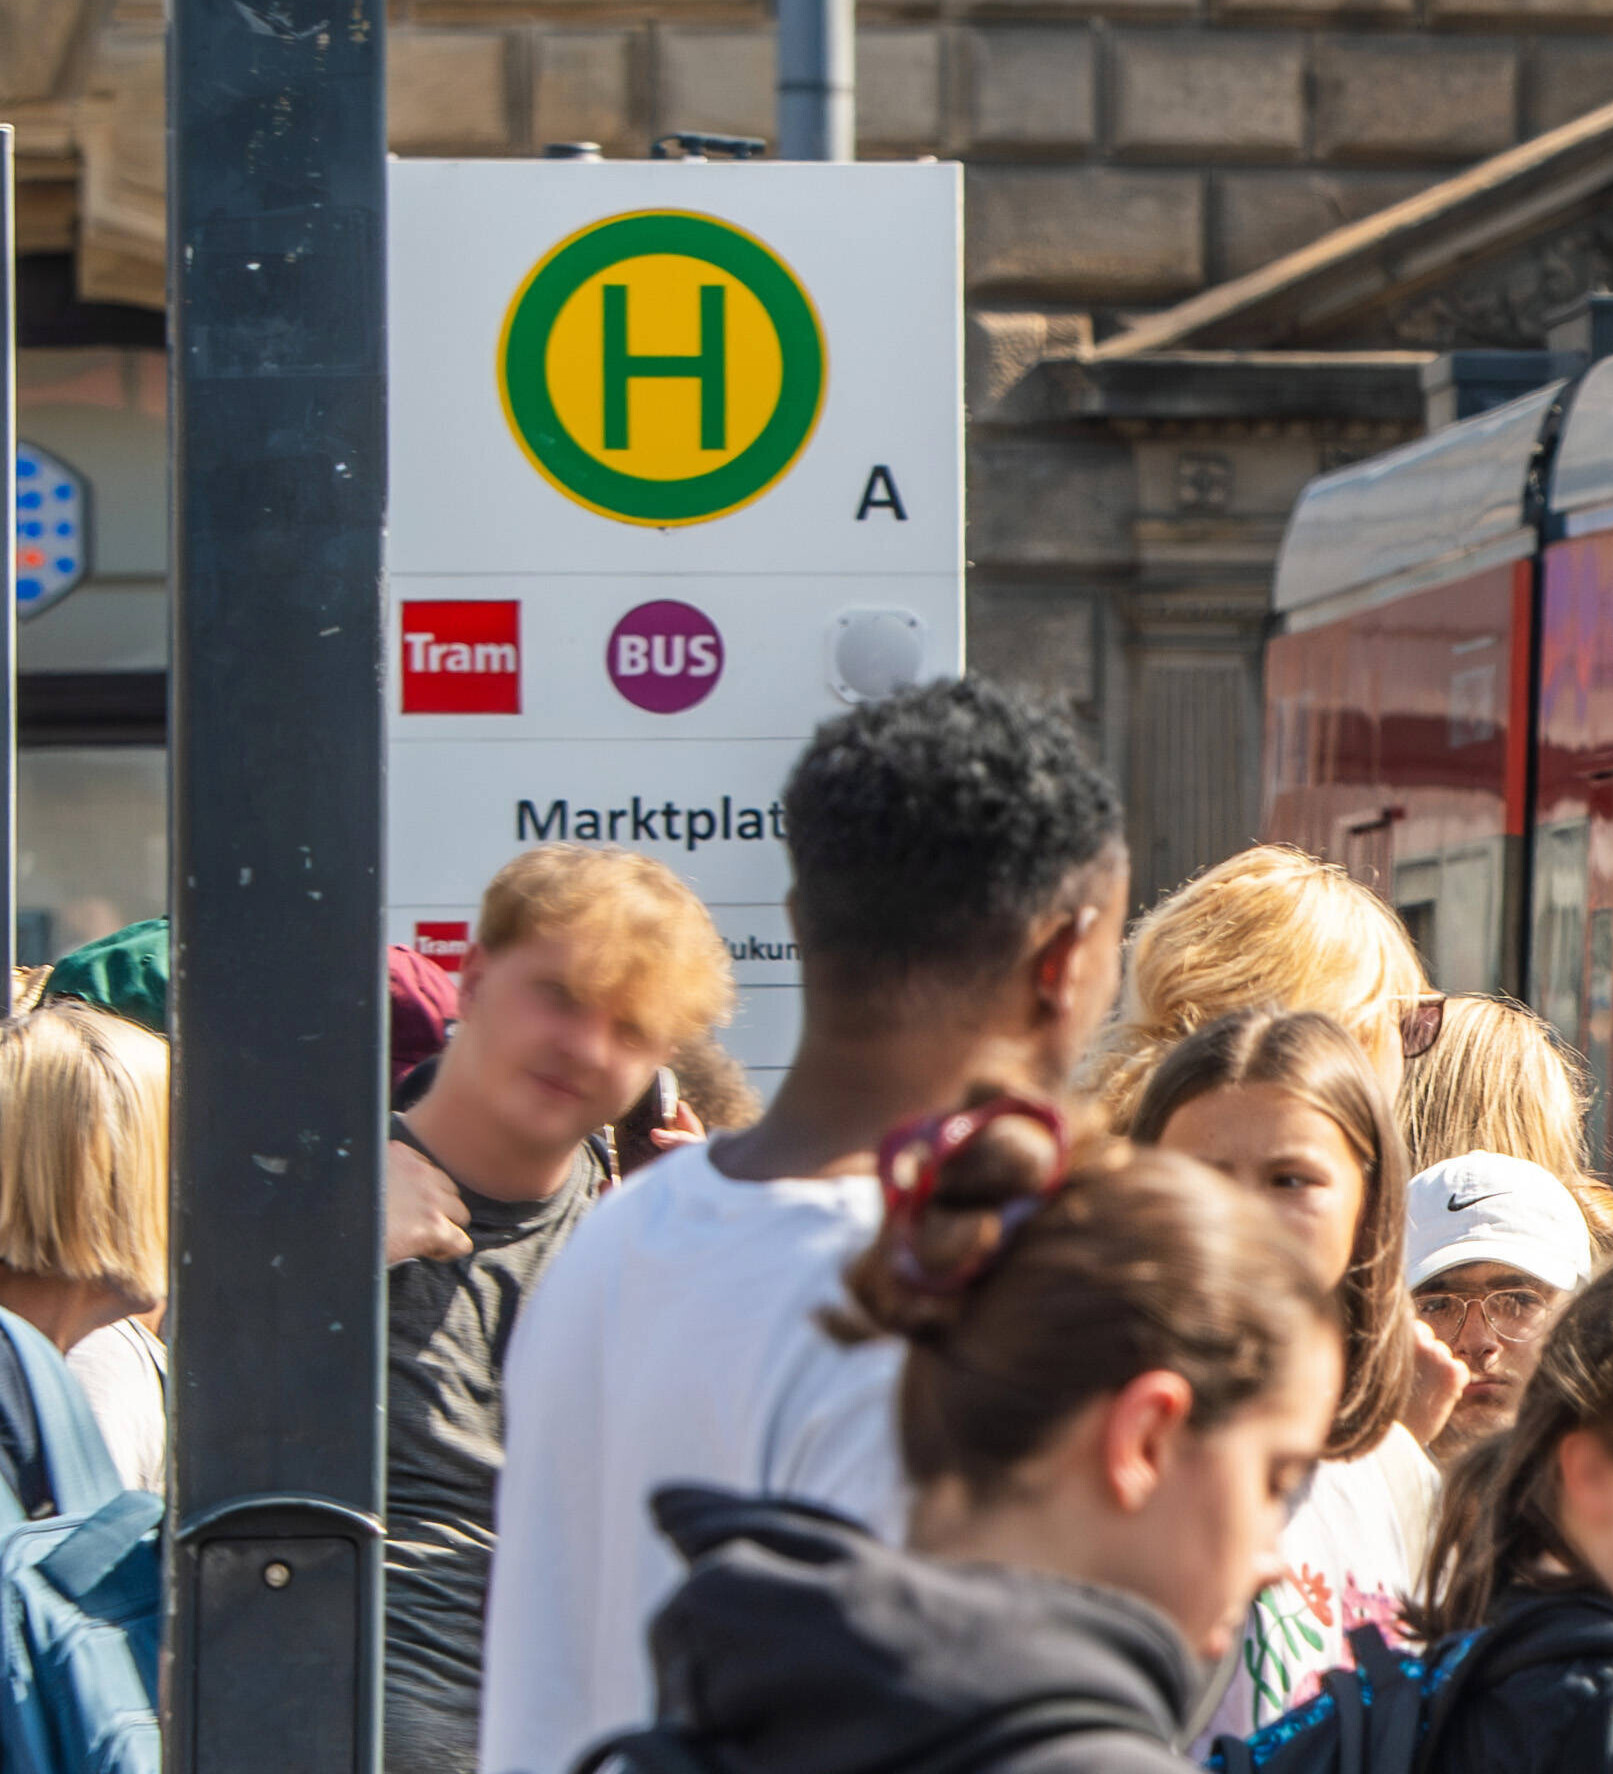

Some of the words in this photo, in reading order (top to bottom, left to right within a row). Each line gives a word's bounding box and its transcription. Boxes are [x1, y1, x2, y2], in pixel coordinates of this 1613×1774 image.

[601, 283, 727, 452] H
[855, 464, 909, 522] A
[404, 632, 518, 675] Tram
[617, 635, 719, 679] BUS
[516, 797, 787, 852] Marktplat
[417, 935, 468, 956] Tram
[722, 933, 800, 961] ukun
